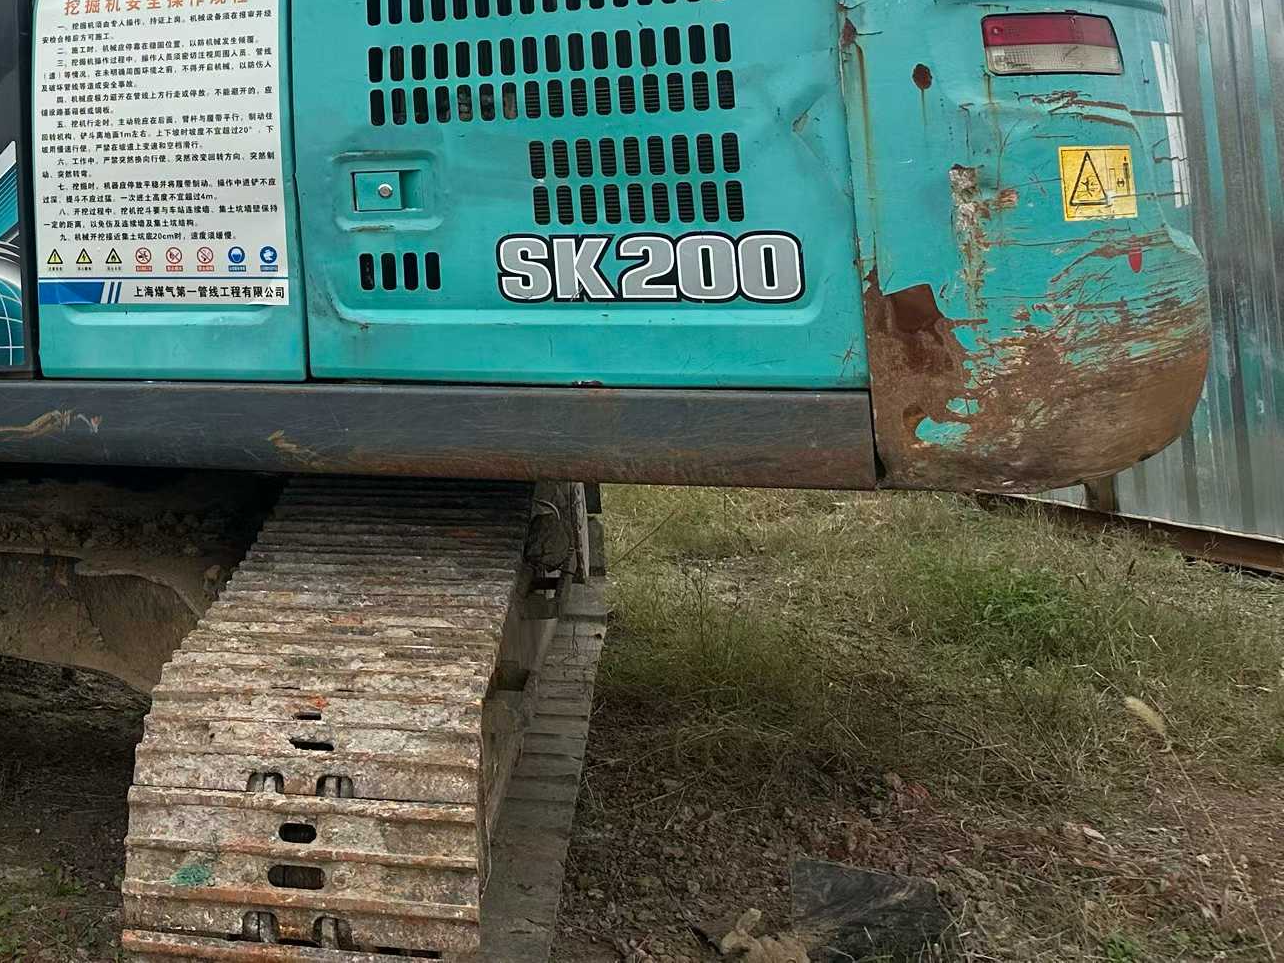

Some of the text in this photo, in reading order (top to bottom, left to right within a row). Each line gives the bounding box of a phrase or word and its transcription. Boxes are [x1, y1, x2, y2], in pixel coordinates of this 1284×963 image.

[497, 231, 805, 303] SK200
[134, 285, 285, 298] 上海煤气第一管线工程有限公司
